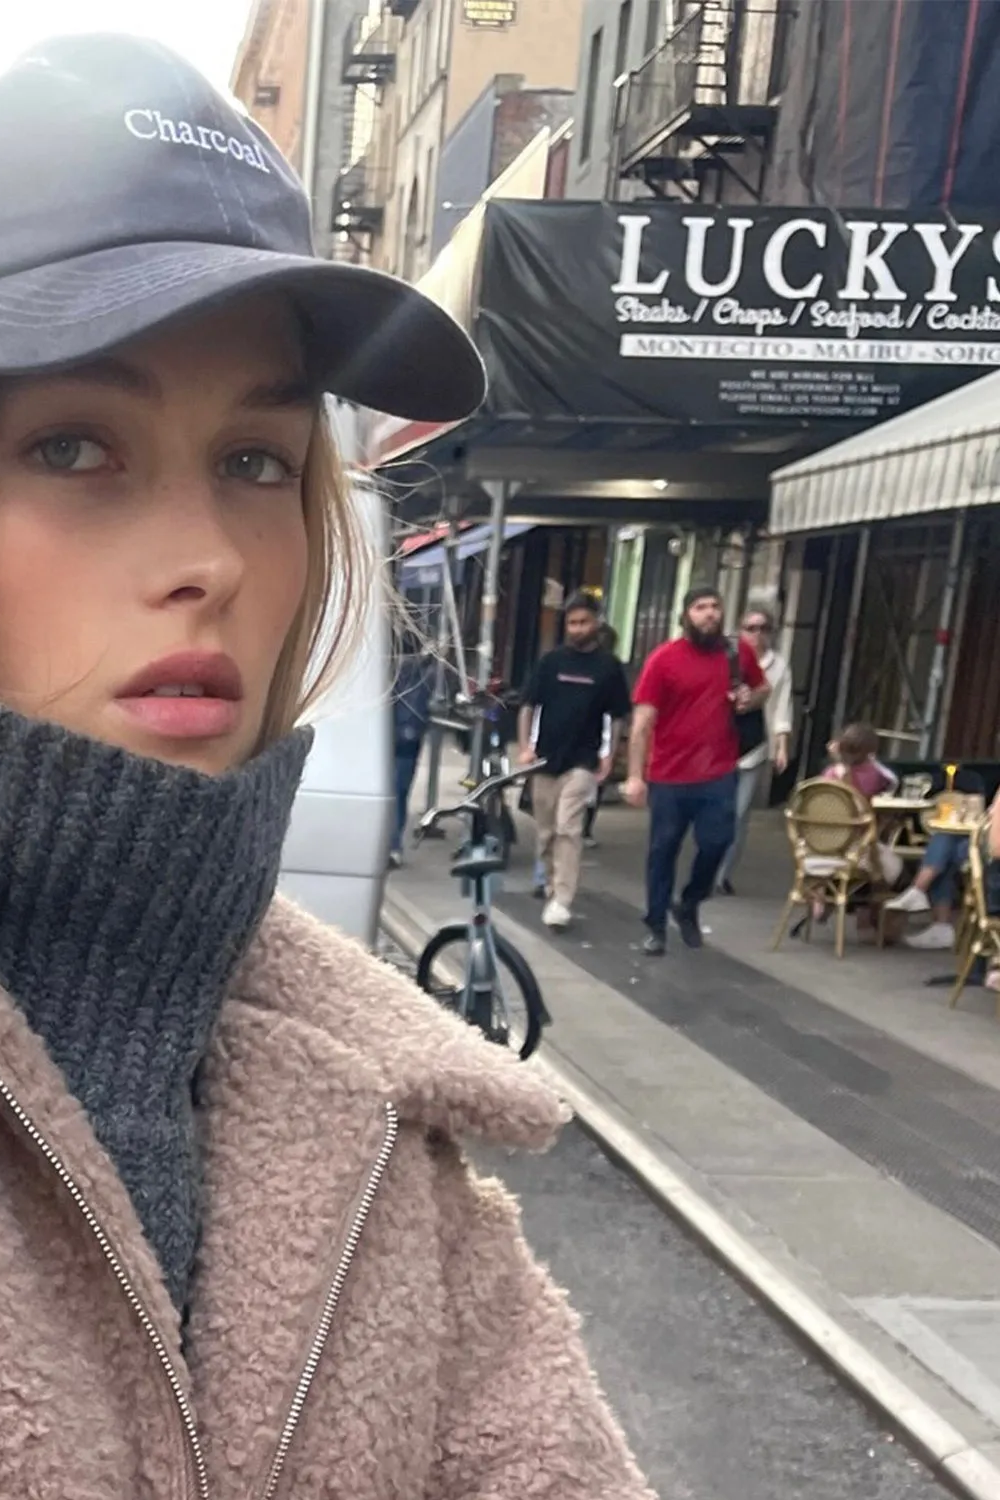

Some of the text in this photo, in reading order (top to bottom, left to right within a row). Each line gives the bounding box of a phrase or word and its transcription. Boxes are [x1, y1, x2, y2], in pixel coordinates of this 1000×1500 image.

[123, 108, 271, 174] Charcoal
[615, 295, 691, 323] Steaks
[712, 297, 788, 336] Chops
[810, 300, 904, 339] Seafood
[637, 338, 793, 358] MONTECITO
[814, 342, 912, 361] MALIBU
